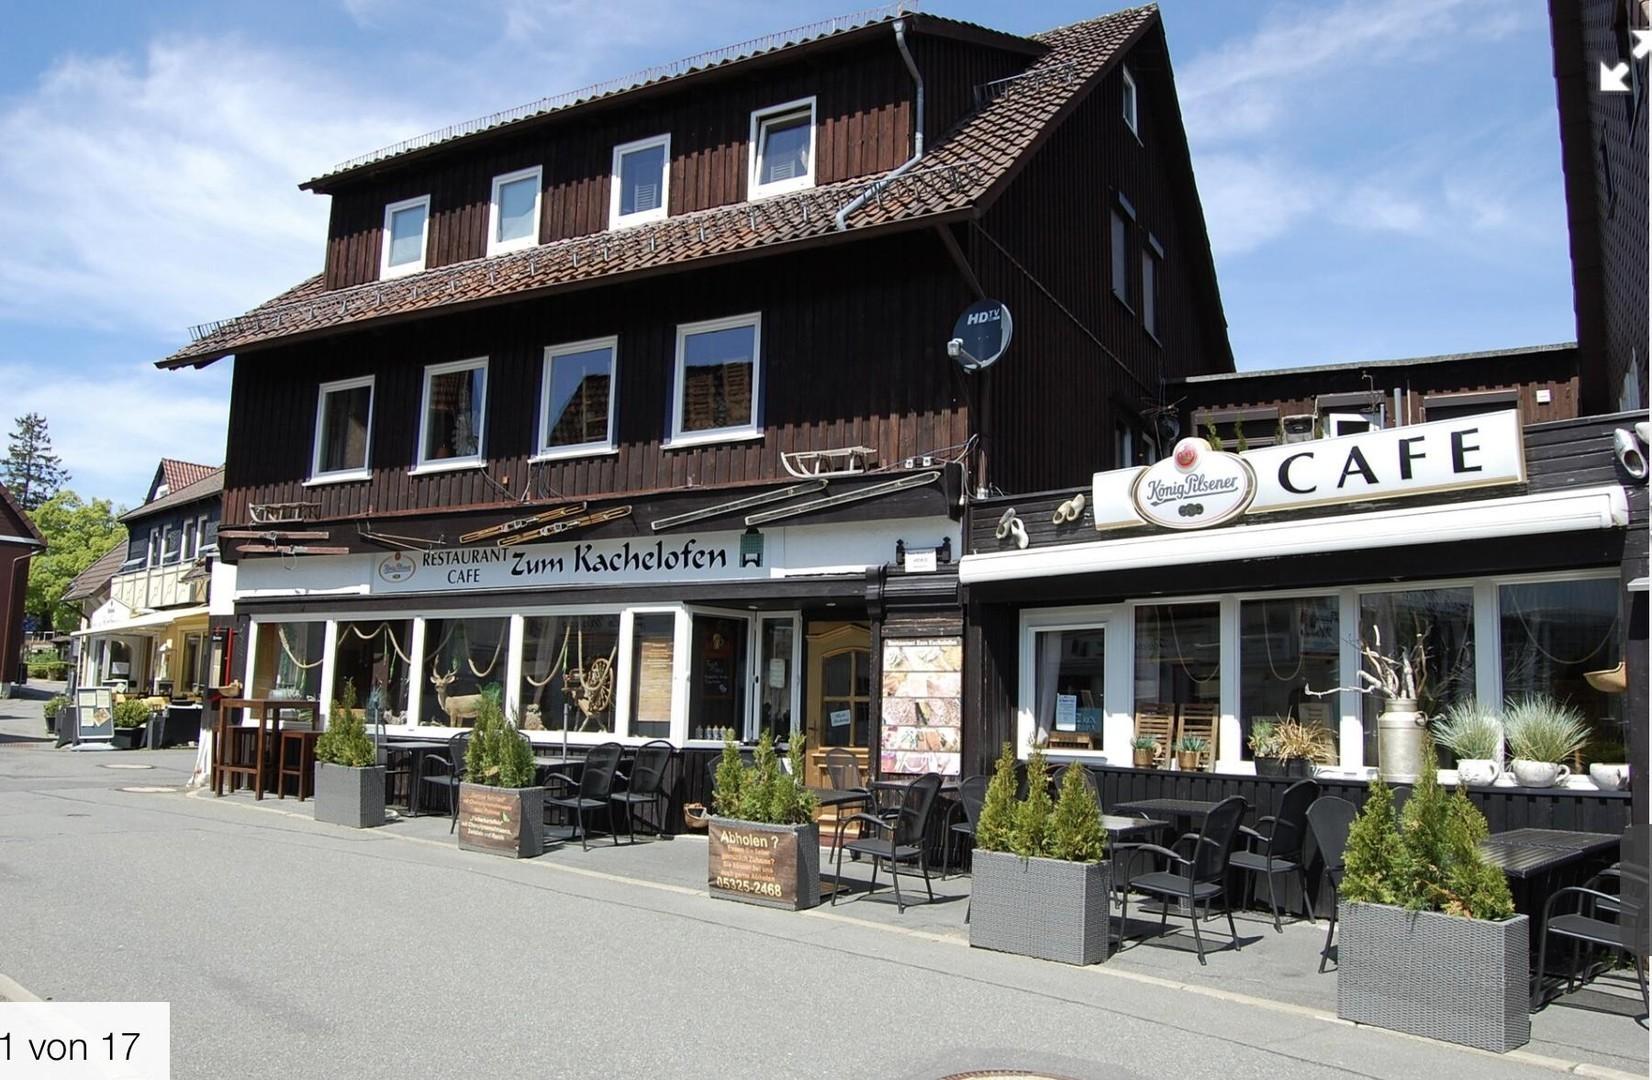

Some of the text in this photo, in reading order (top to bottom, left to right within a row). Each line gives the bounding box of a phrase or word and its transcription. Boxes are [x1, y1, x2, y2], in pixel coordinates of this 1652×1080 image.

[1277, 427, 1482, 494] CAFE
[1147, 473, 1238, 500] König Pilsener
[422, 547, 509, 566] RESTAURANT
[511, 539, 726, 576] Zum Kachelofen
[447, 569, 480, 584] CAFE
[720, 830, 779, 848] Abholen ?
[716, 876, 782, 897] 05325-2468
